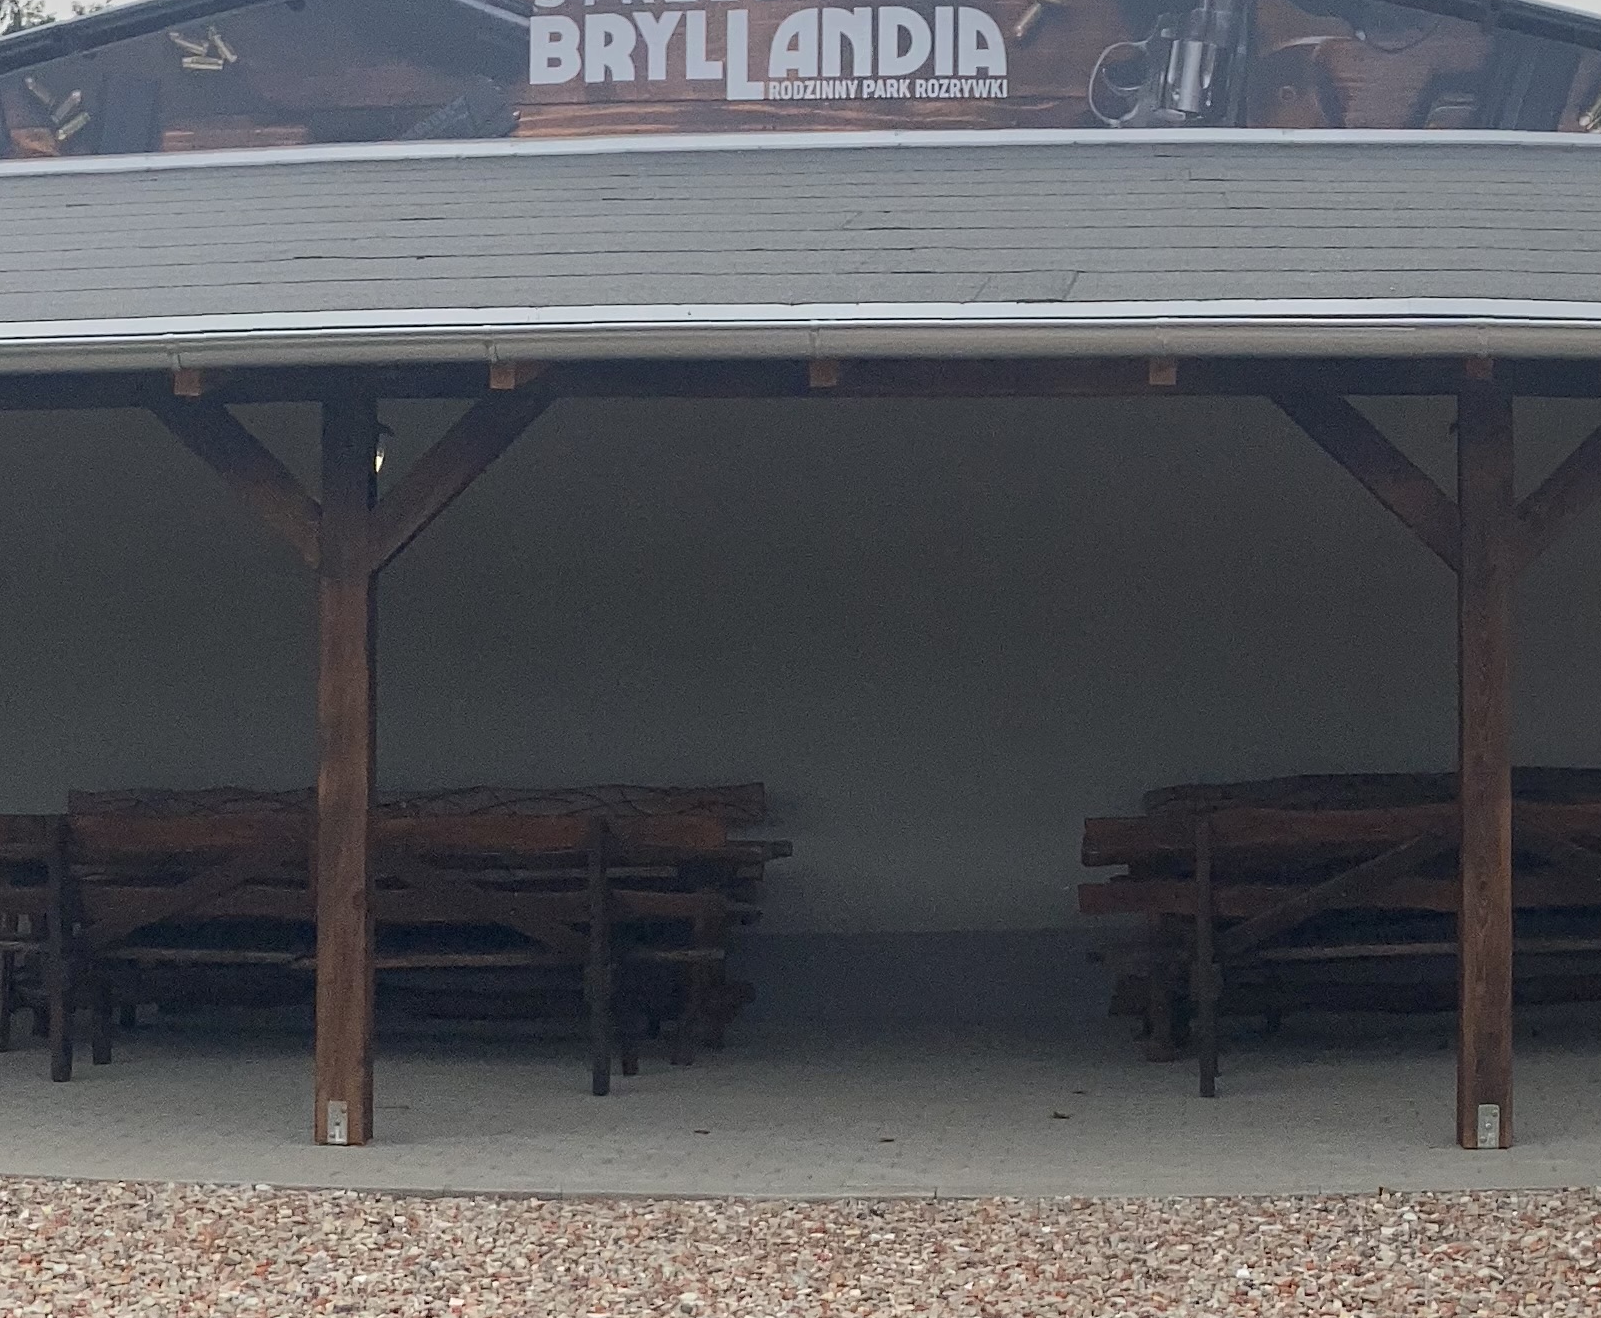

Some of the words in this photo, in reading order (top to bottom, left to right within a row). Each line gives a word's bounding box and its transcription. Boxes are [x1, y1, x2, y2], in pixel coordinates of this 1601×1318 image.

[529, 6, 1008, 101] BRYLLANDIA
[769, 81, 859, 101] RODZINNY
[862, 79, 911, 99] PARK
[915, 78, 1008, 99] ROZRYWKI
